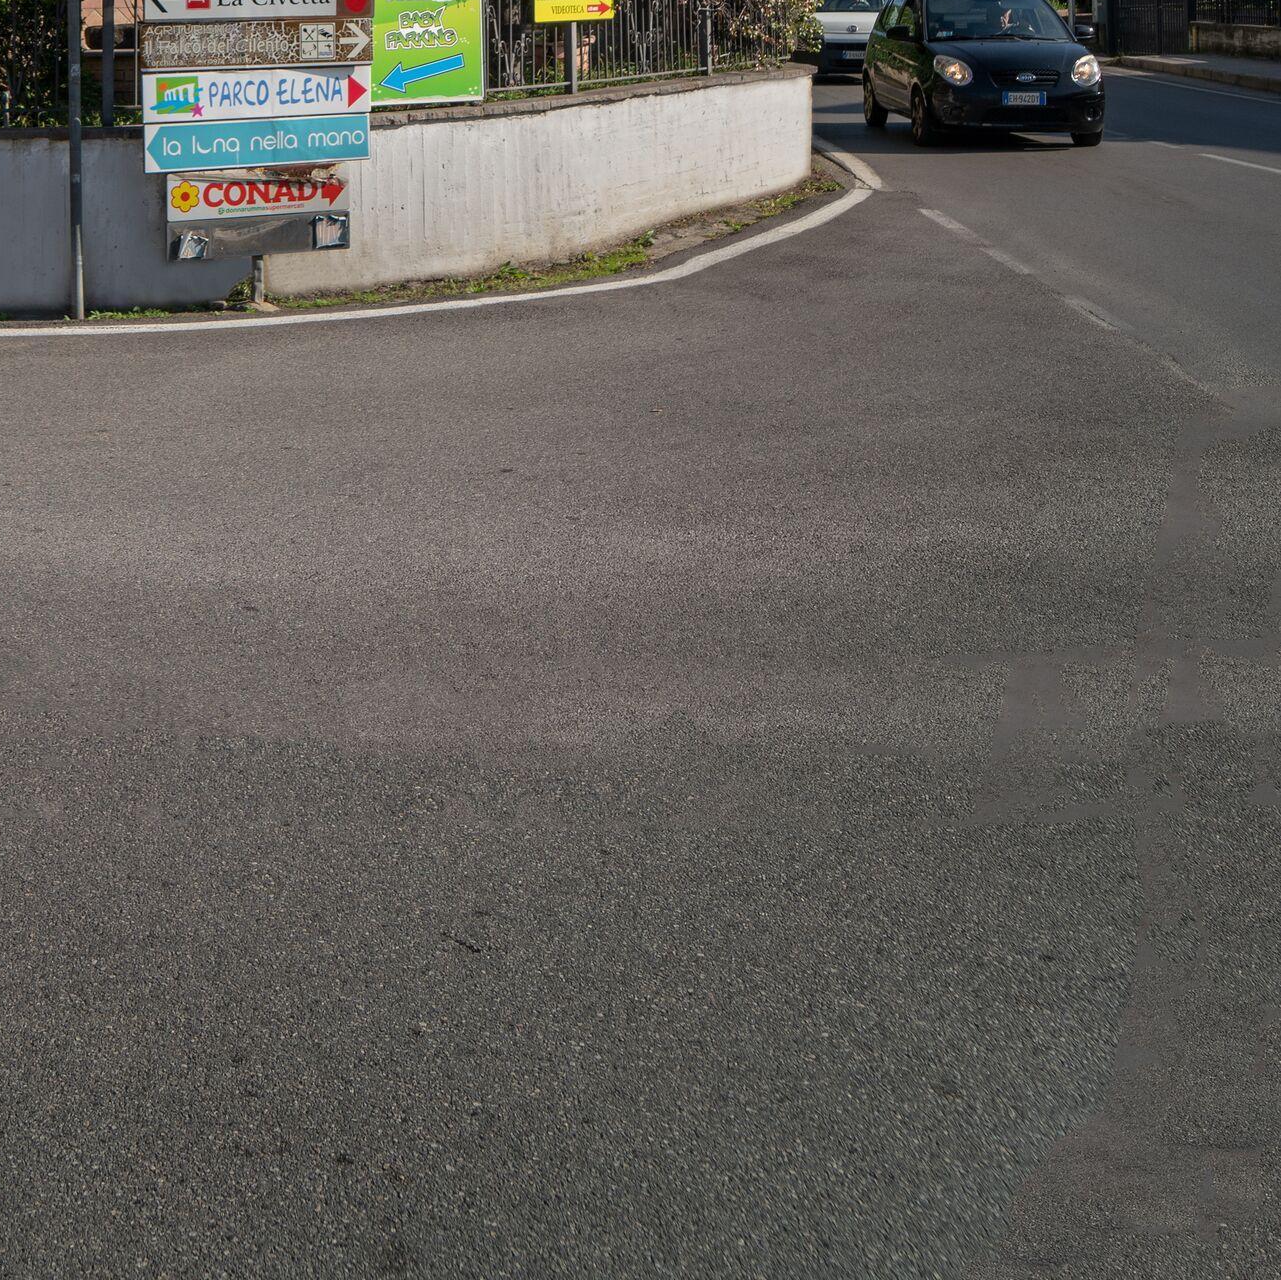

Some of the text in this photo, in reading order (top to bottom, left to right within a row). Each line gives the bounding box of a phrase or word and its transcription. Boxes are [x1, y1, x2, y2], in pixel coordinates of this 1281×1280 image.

[398, 6, 446, 29] BABY
[551, 5, 584, 14] VIDEOTECA
[157, 40, 200, 54] Falco
[207, 38, 230, 53] del
[236, 38, 289, 53] Cilento
[385, 29, 458, 50] PARKING
[209, 77, 343, 107] PARCO ELENA
[162, 130, 364, 156] la luna nella mano
[202, 181, 318, 208] CONAD
